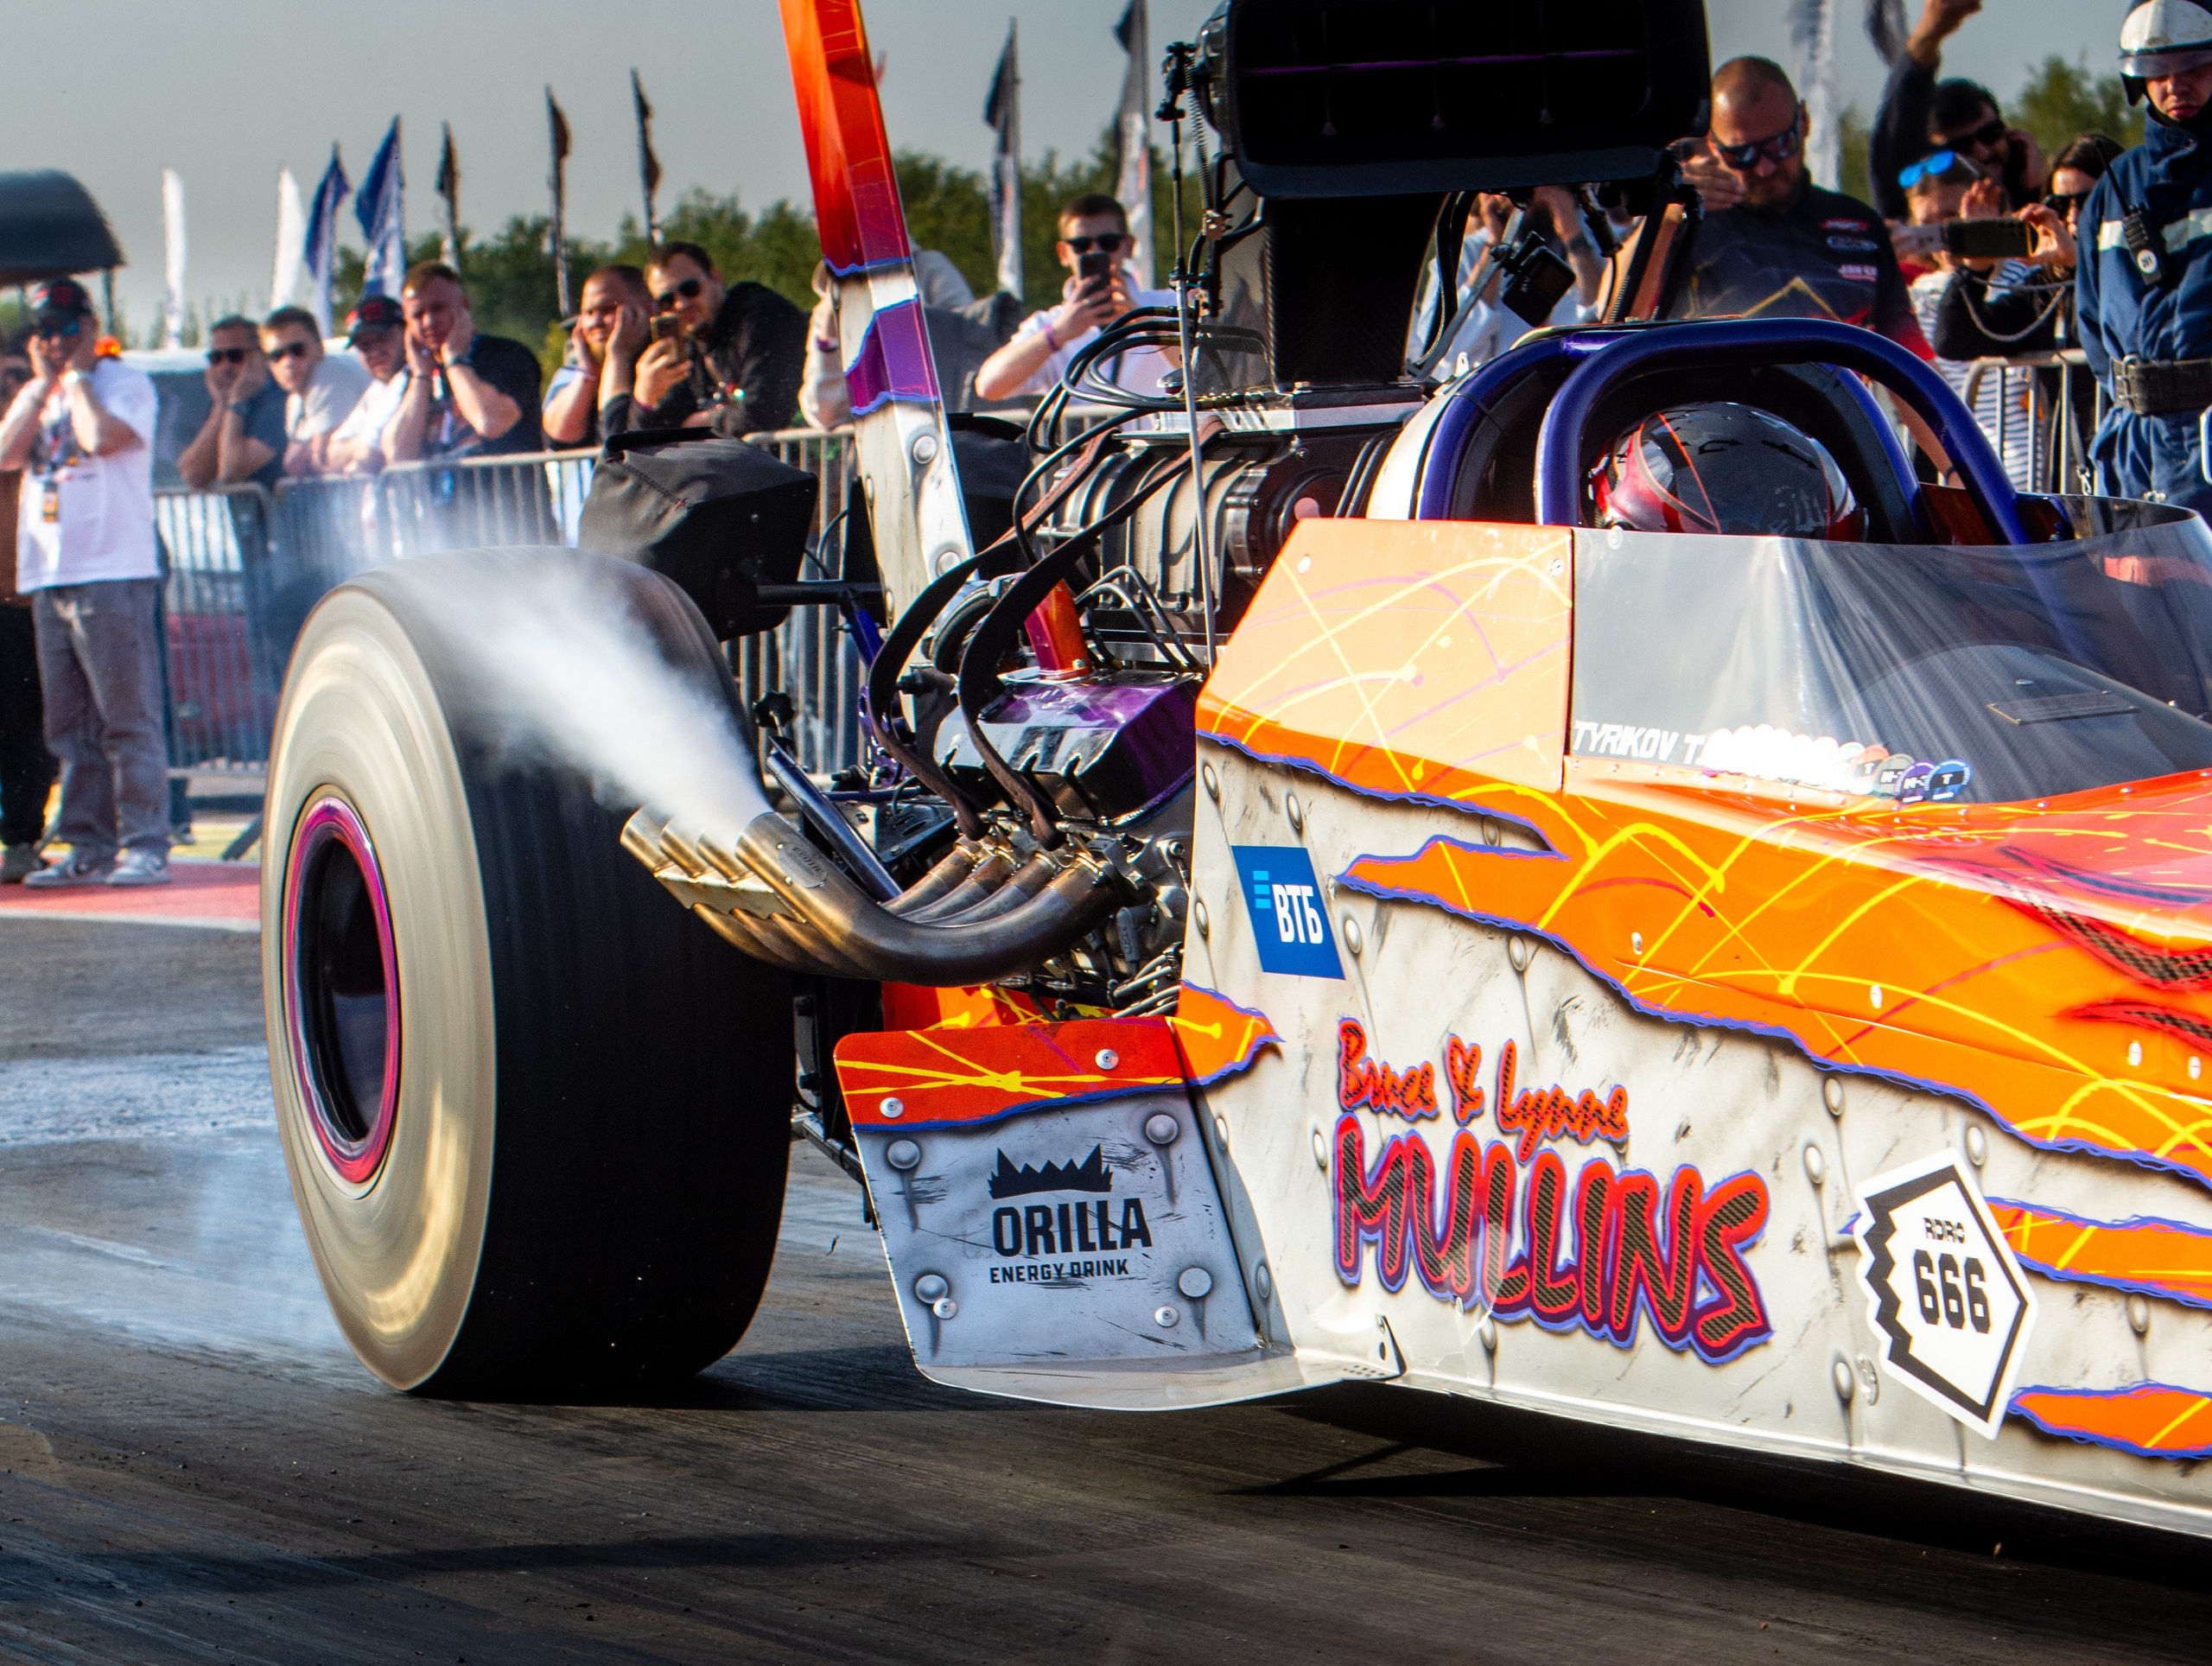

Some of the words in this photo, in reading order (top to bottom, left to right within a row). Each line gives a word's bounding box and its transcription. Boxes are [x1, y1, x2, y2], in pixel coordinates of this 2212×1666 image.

[1573, 720, 1680, 761] TYRIKOV
[1272, 884, 1323, 944] ВТБ
[1447, 1033, 1484, 1125] &
[1497, 1039, 1630, 1165] Lynne
[993, 1198, 1154, 1257] ORILLA
[1335, 1113, 1774, 1365] MULLINS
[989, 1263, 1065, 1283] ENERGY
[1071, 1259, 1129, 1279] DRINK
[1913, 1249, 1991, 1334] 666
